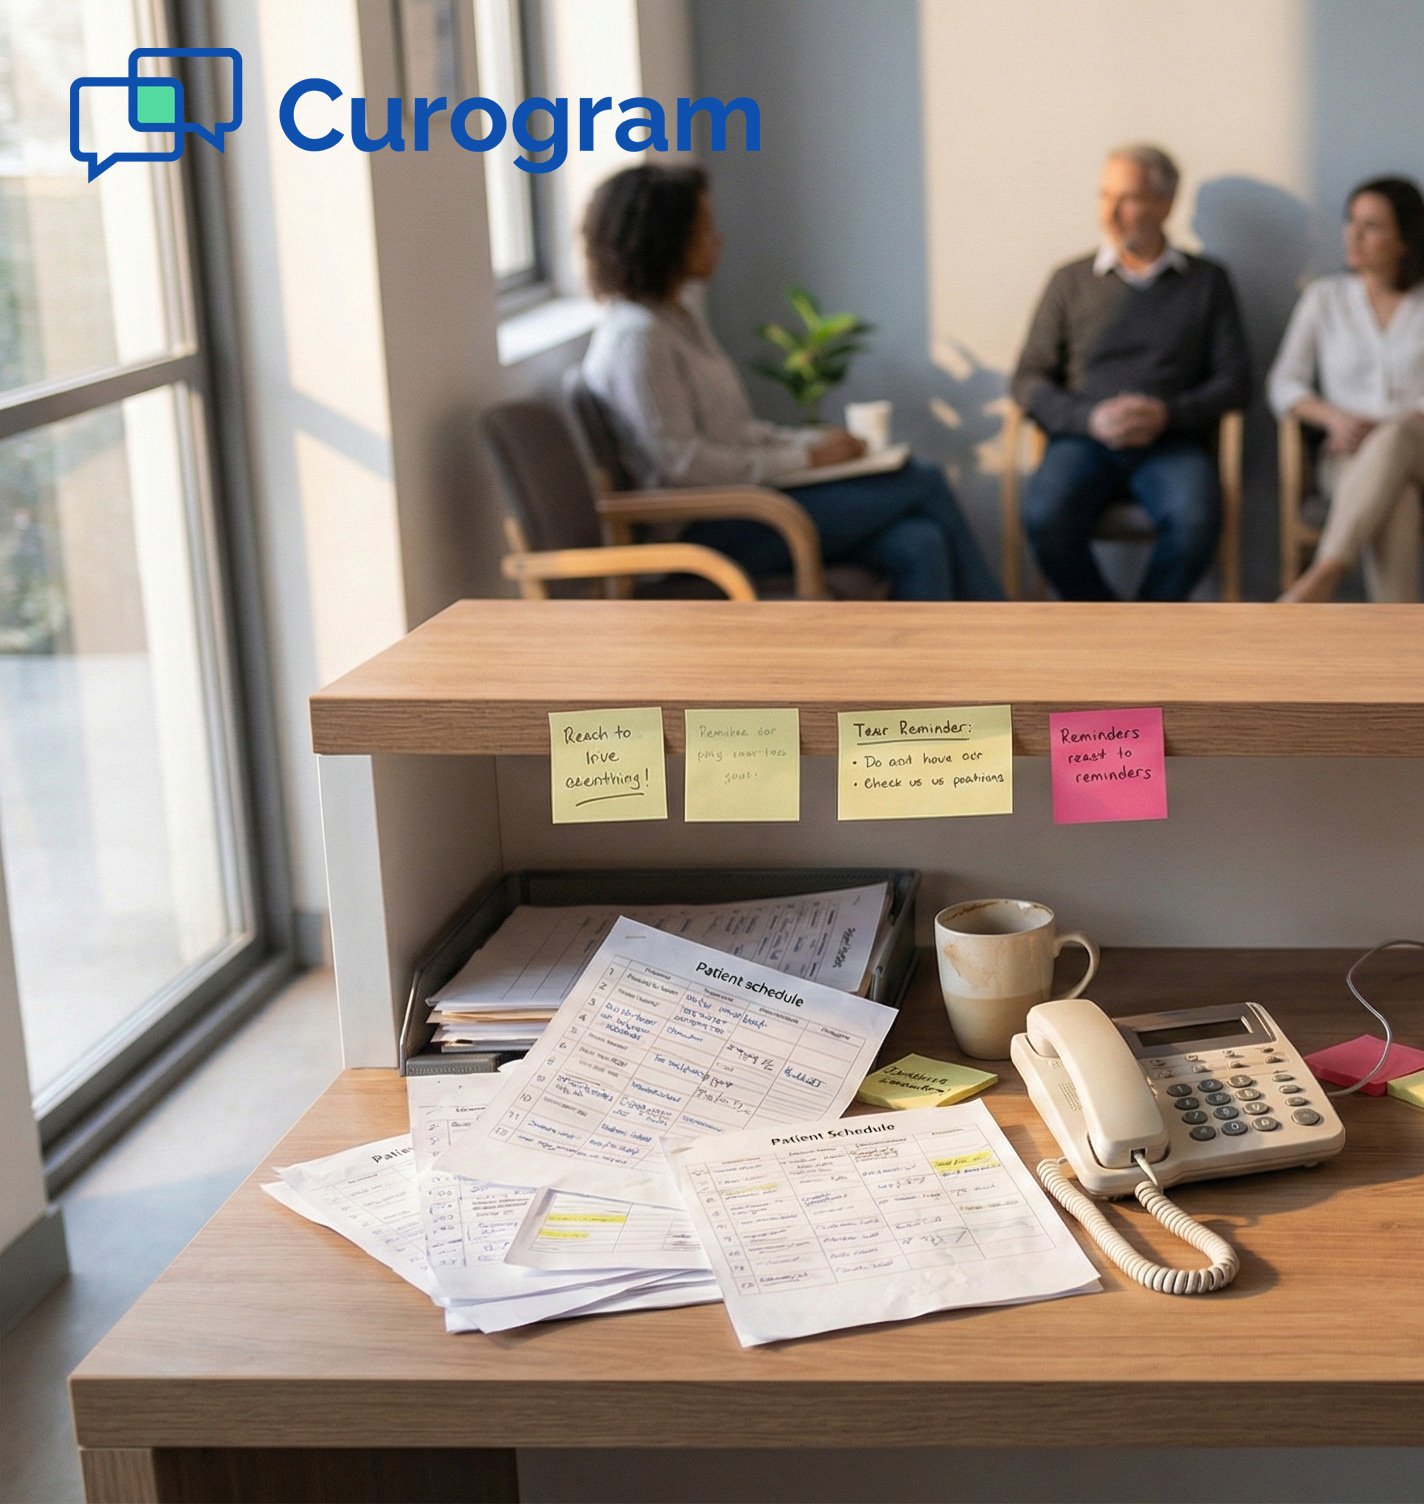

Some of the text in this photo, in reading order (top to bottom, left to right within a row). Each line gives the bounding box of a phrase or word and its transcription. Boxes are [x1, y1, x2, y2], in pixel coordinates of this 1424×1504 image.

[563, 725, 632, 744] Reach to
[1060, 726, 1141, 745] Reminders
[1117, 746, 1133, 759] to
[864, 755, 882, 769] Do
[1075, 765, 1152, 783] reminders
[864, 777, 902, 790] Check
[909, 779, 923, 788] us
[931, 777, 945, 786] us
[695, 961, 744, 987] Patient
[744, 980, 805, 1008] schedule
[770, 1132, 824, 1146] Patient
